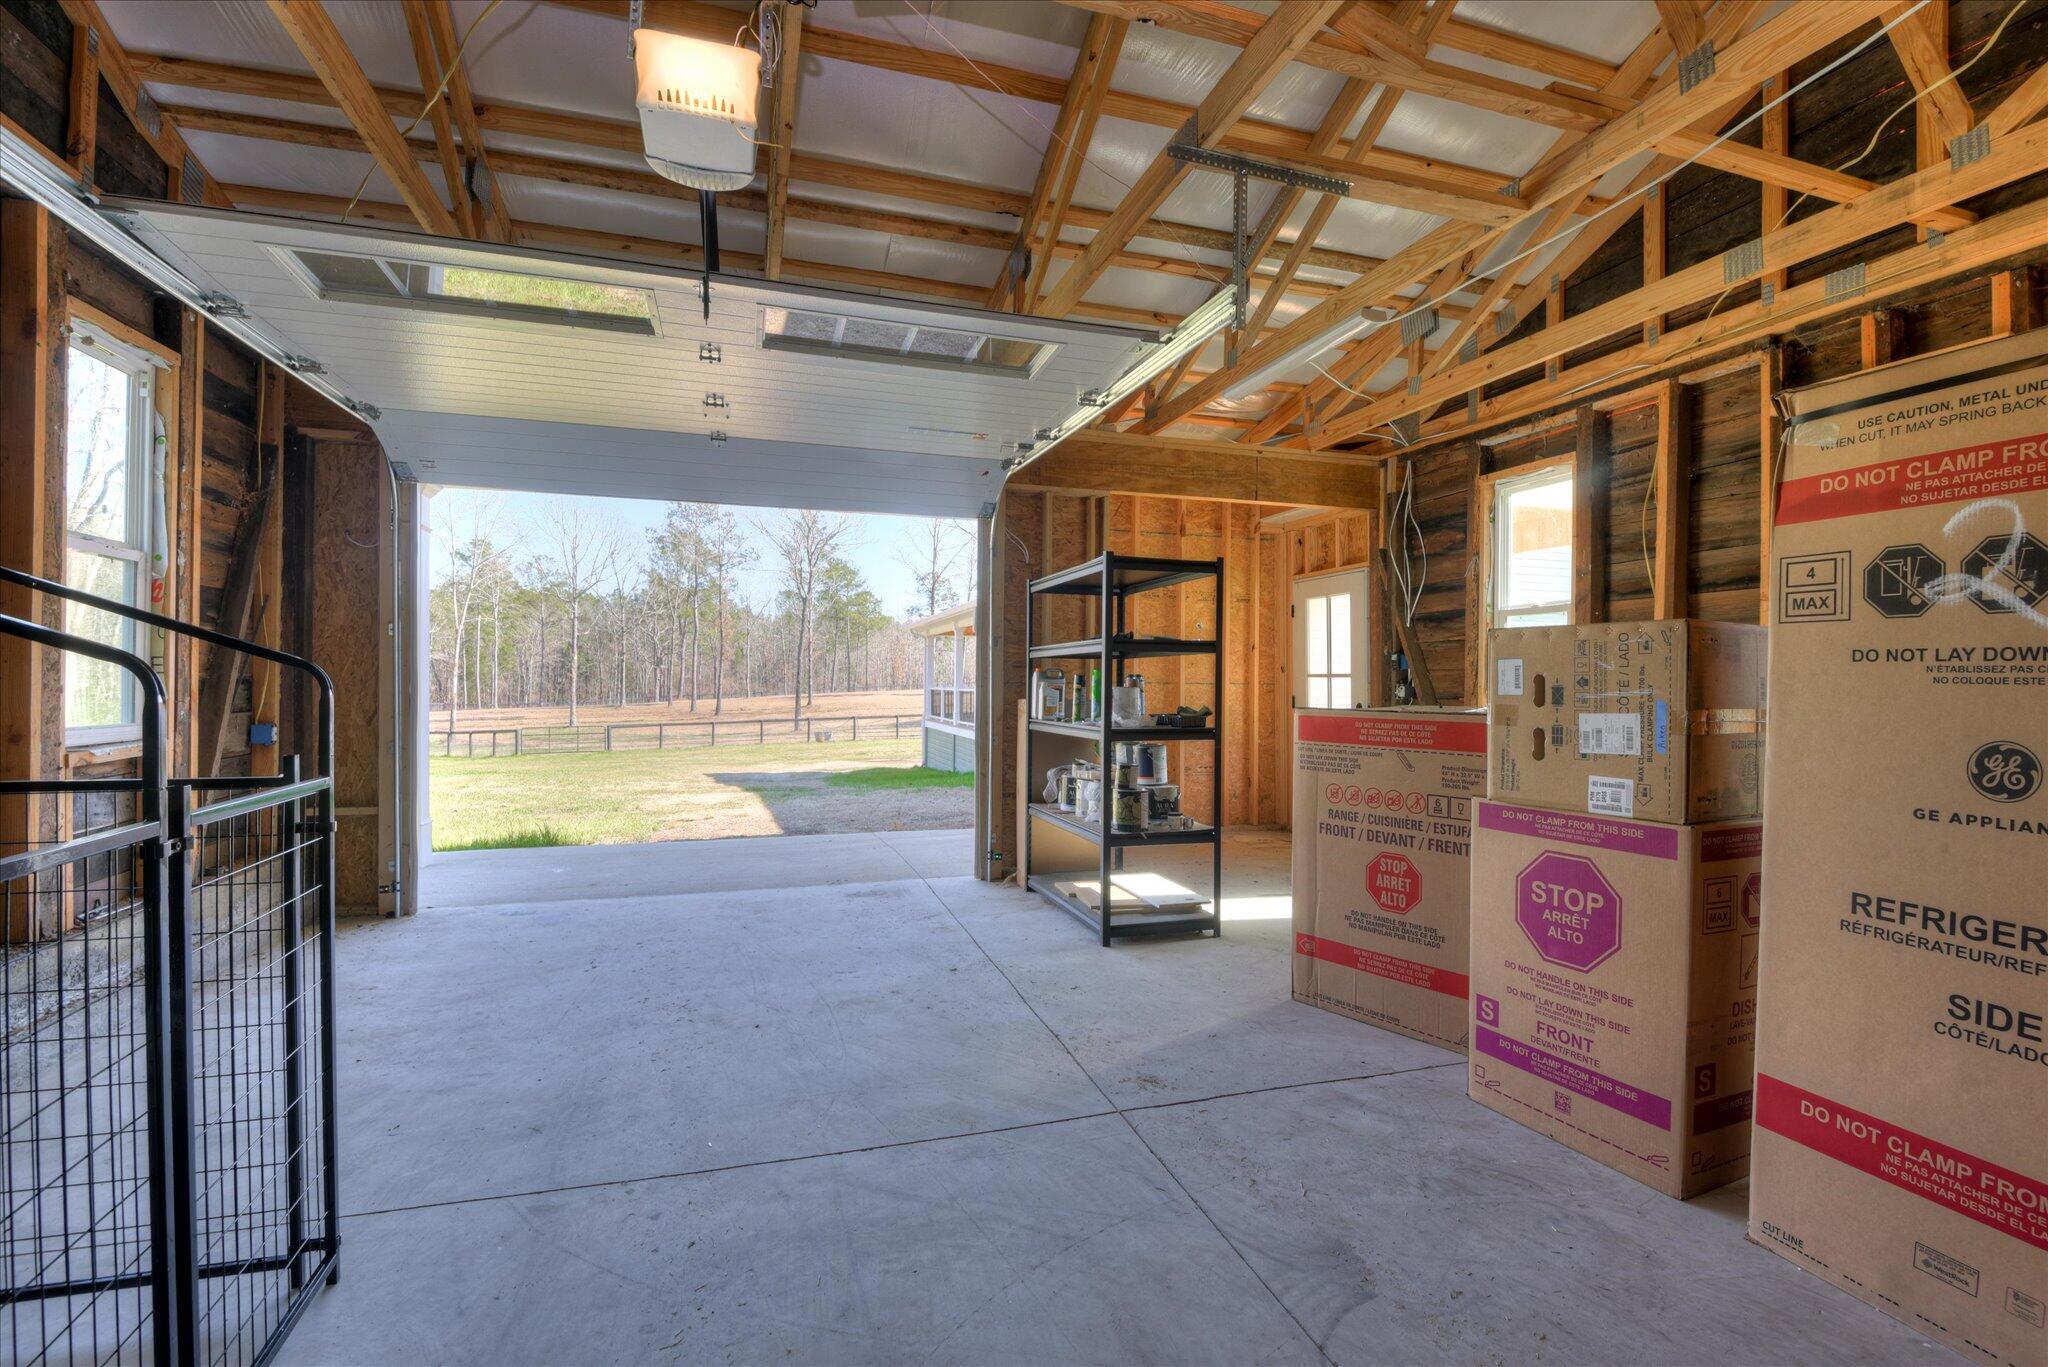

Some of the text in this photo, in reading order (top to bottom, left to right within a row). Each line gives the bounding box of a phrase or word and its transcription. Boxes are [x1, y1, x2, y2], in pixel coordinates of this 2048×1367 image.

[1820, 395, 2047, 451] WHEN CUT, IT MAY SPRING BACK
[1858, 415, 1882, 429] USE
[1887, 401, 1954, 423] CAUTION,
[1959, 389, 2011, 407] METAL
[1820, 477, 1849, 494] DO
[1855, 465, 1900, 487] NOT
[1906, 449, 1994, 479] CLAMP
[1905, 461, 2046, 491] NE PAS ATTACHER DE
[1900, 475, 2048, 504] NO SUJETAR DESDE EL
[1806, 566, 1816, 579] 4
[1792, 595, 1829, 610] MAX
[1618, 632, 1630, 668] LADO
[1852, 648, 1879, 662] DO
[1886, 648, 1928, 662] NOT
[1935, 647, 1976, 662] LAY
[1933, 676, 2046, 686] NO COLOQUE ESTE
[2010, 665, 2034, 674] PAS
[1434, 799, 1441, 807] 6
[1328, 808, 1359, 822] RANGE
[1367, 813, 1424, 832] CUISINIÈRE
[1502, 810, 1515, 818] DO
[1517, 811, 1534, 820] NOT
[1535, 815, 1567, 825] CLAMP
[1568, 819, 1595, 831] FROM
[1597, 824, 1619, 835] THIS
[1621, 827, 1645, 839] SIDE
[1913, 808, 2048, 836] GE APPLIAN
[1319, 822, 1356, 839] FRONT
[1367, 829, 1416, 848] DEVANT
[1380, 858, 1408, 875] STOP
[1380, 891, 1406, 908] ALTO
[1531, 880, 1604, 915] STOP
[1351, 909, 1359, 917] DO
[1373, 915, 1397, 925] HANDLE
[1408, 922, 1422, 931] THIS
[1423, 926, 1438, 935] SIDE
[1353, 916, 1364, 924] PAS
[1366, 918, 1400, 933] MANIPULER
[1401, 927, 1418, 935] DANS
[1420, 931, 1428, 939] CE
[1542, 908, 1590, 930] ARRÊT
[1710, 911, 1728, 922] MAX
[1851, 891, 2048, 956] REFRIGER
[1358, 924, 1392, 938] MANIPULAR
[1394, 933, 1406, 941] POR
[1407, 936, 1424, 945] ESTE
[1424, 940, 1441, 949] LADO
[1547, 925, 1584, 945] ALTO
[1840, 919, 2047, 976] RÉFRIGÉRATEUR/REF
[1361, 950, 1372, 958] NOT
[1373, 953, 1392, 963] CLAMP
[1504, 960, 1517, 970] DO
[1518, 964, 1535, 976] NOT
[1536, 970, 1571, 988] HANDLE
[1573, 982, 1586, 992] ON
[1588, 986, 1609, 1000] THIS
[1611, 993, 1634, 1008] SIDE
[1481, 1000, 1494, 1021] S
[1507, 986, 1518, 996] DO
[1520, 991, 1536, 1002] NOT
[1539, 997, 1554, 1008] LAY
[1556, 1002, 1583, 1019] DOWN
[1585, 1012, 1606, 1027] THIS
[1608, 1020, 1631, 1035] SIDE
[1947, 994, 2043, 1043] SIDE
[1536, 1020, 1594, 1053] FRONT
[1530, 1034, 1600, 1068] DEVANT/FRENTE
[1500, 1039, 1511, 1050] DO
[1512, 1044, 1529, 1057] NOT
[1531, 1051, 1561, 1069] CLAMP
[1563, 1064, 1589, 1082] FROM
[1591, 1076, 1613, 1091] THIS
[1615, 1085, 1638, 1101] SIDE
[1699, 1069, 1711, 1092] S
[1800, 1100, 1830, 1124] DO
[1836, 1114, 1881, 1144] NOT
[1887, 1135, 1973, 1179] CLAMP
[1880, 1162, 1898, 1176] NO
[1900, 1171, 1956, 1202] SUJETAR
[1960, 1196, 2006, 1224] DESDE
[2009, 1217, 2028, 1233] EL
[1885, 1153, 2047, 1228] NE PAS ATTACHER DE CE
[1762, 1221, 1804, 1250] CUT LINE
